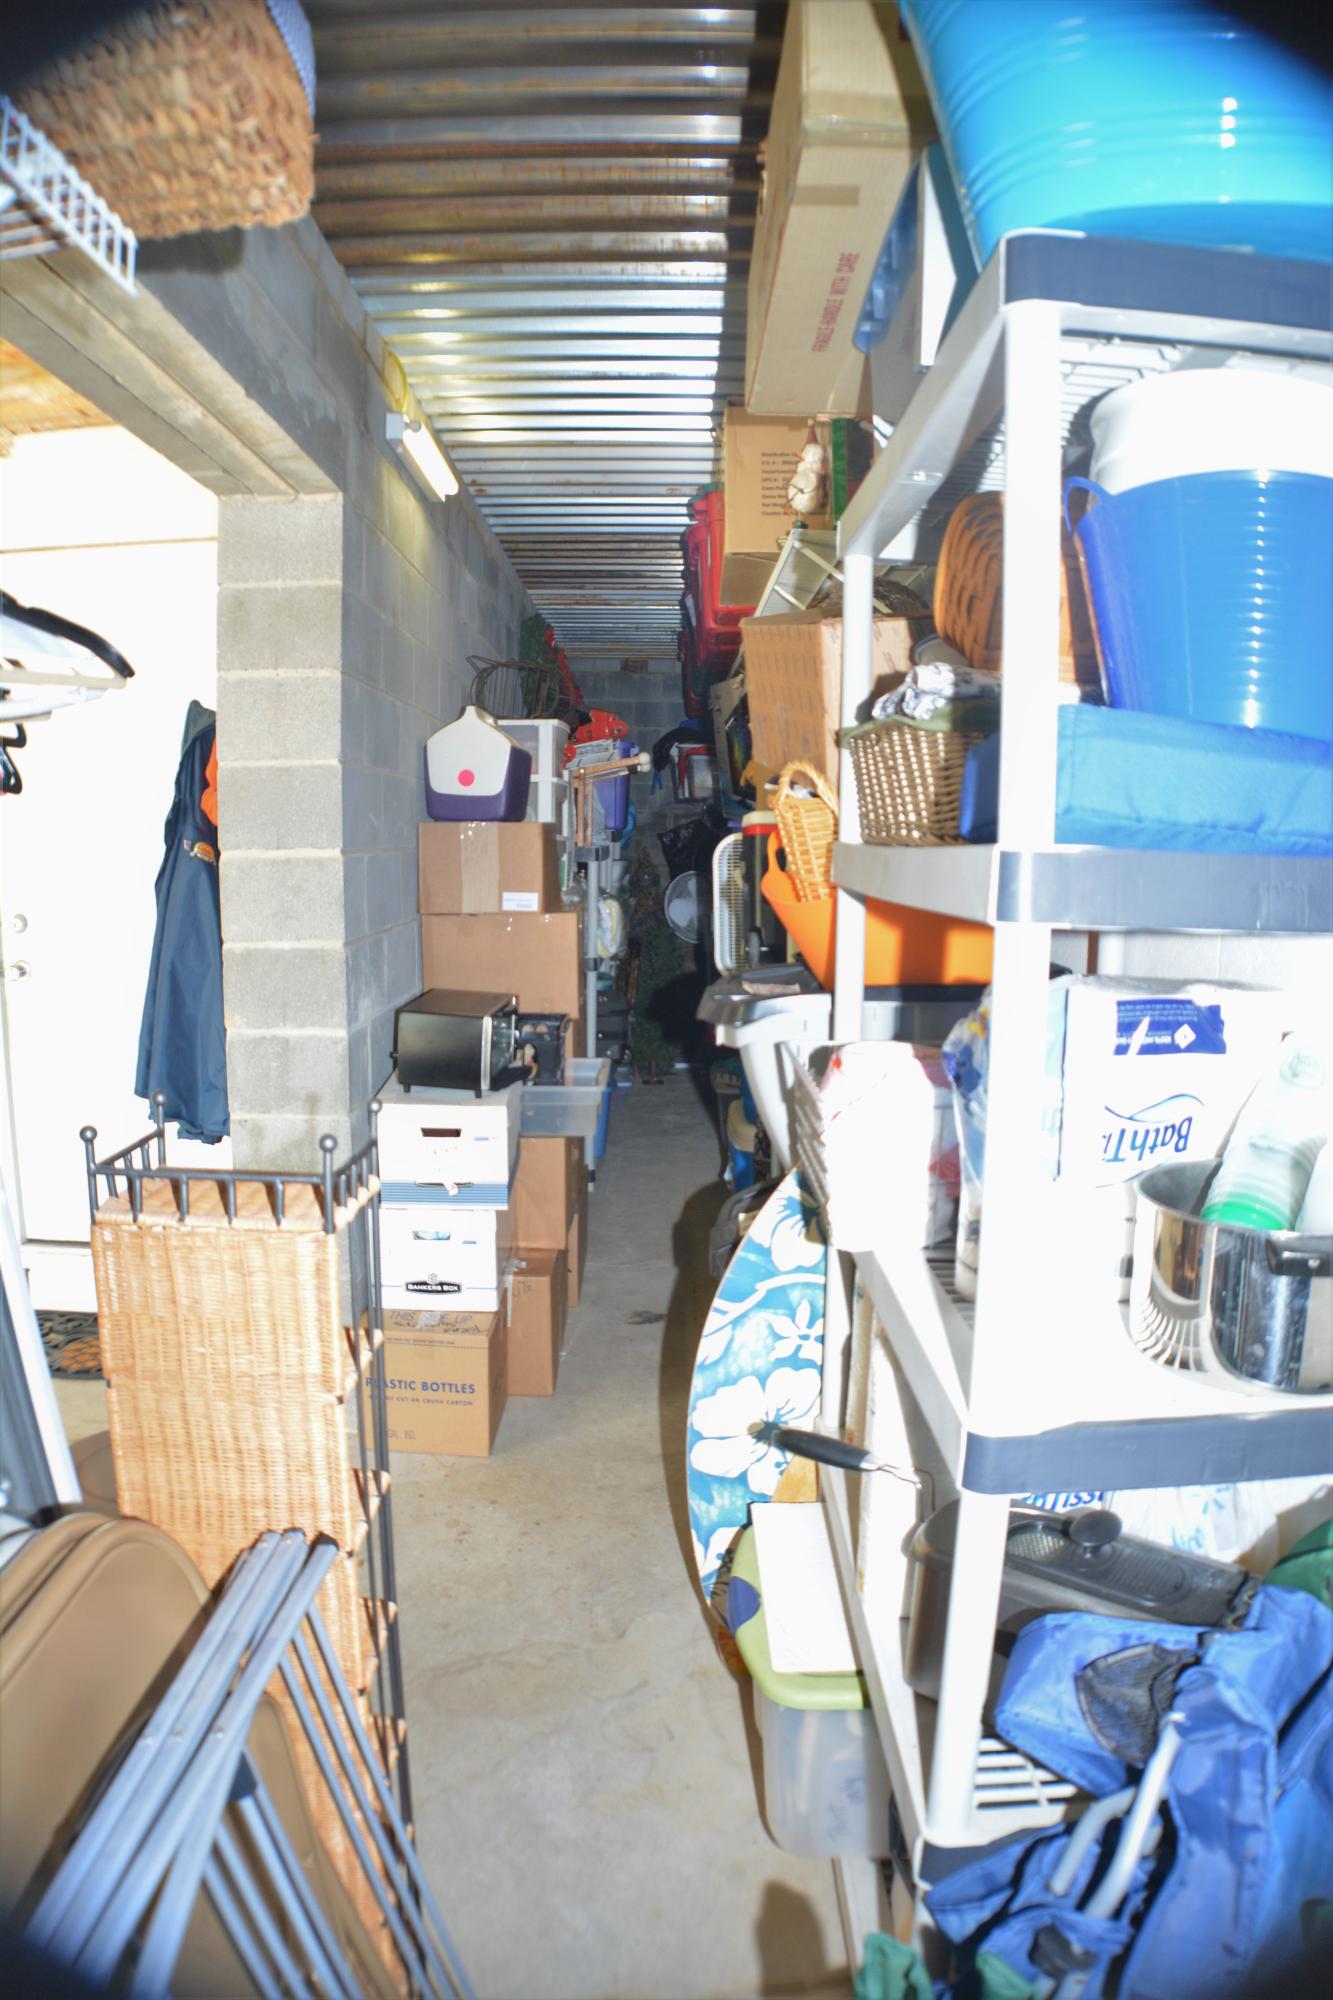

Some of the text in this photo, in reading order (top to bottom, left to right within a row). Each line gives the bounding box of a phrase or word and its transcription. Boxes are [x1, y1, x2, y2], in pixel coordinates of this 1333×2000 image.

[835, 252, 861, 273] CARE
[829, 275, 850, 296] WITH
[365, 1376, 476, 1394] PSTIC BOTTLES
[446, 1399, 474, 1407] CARTON
